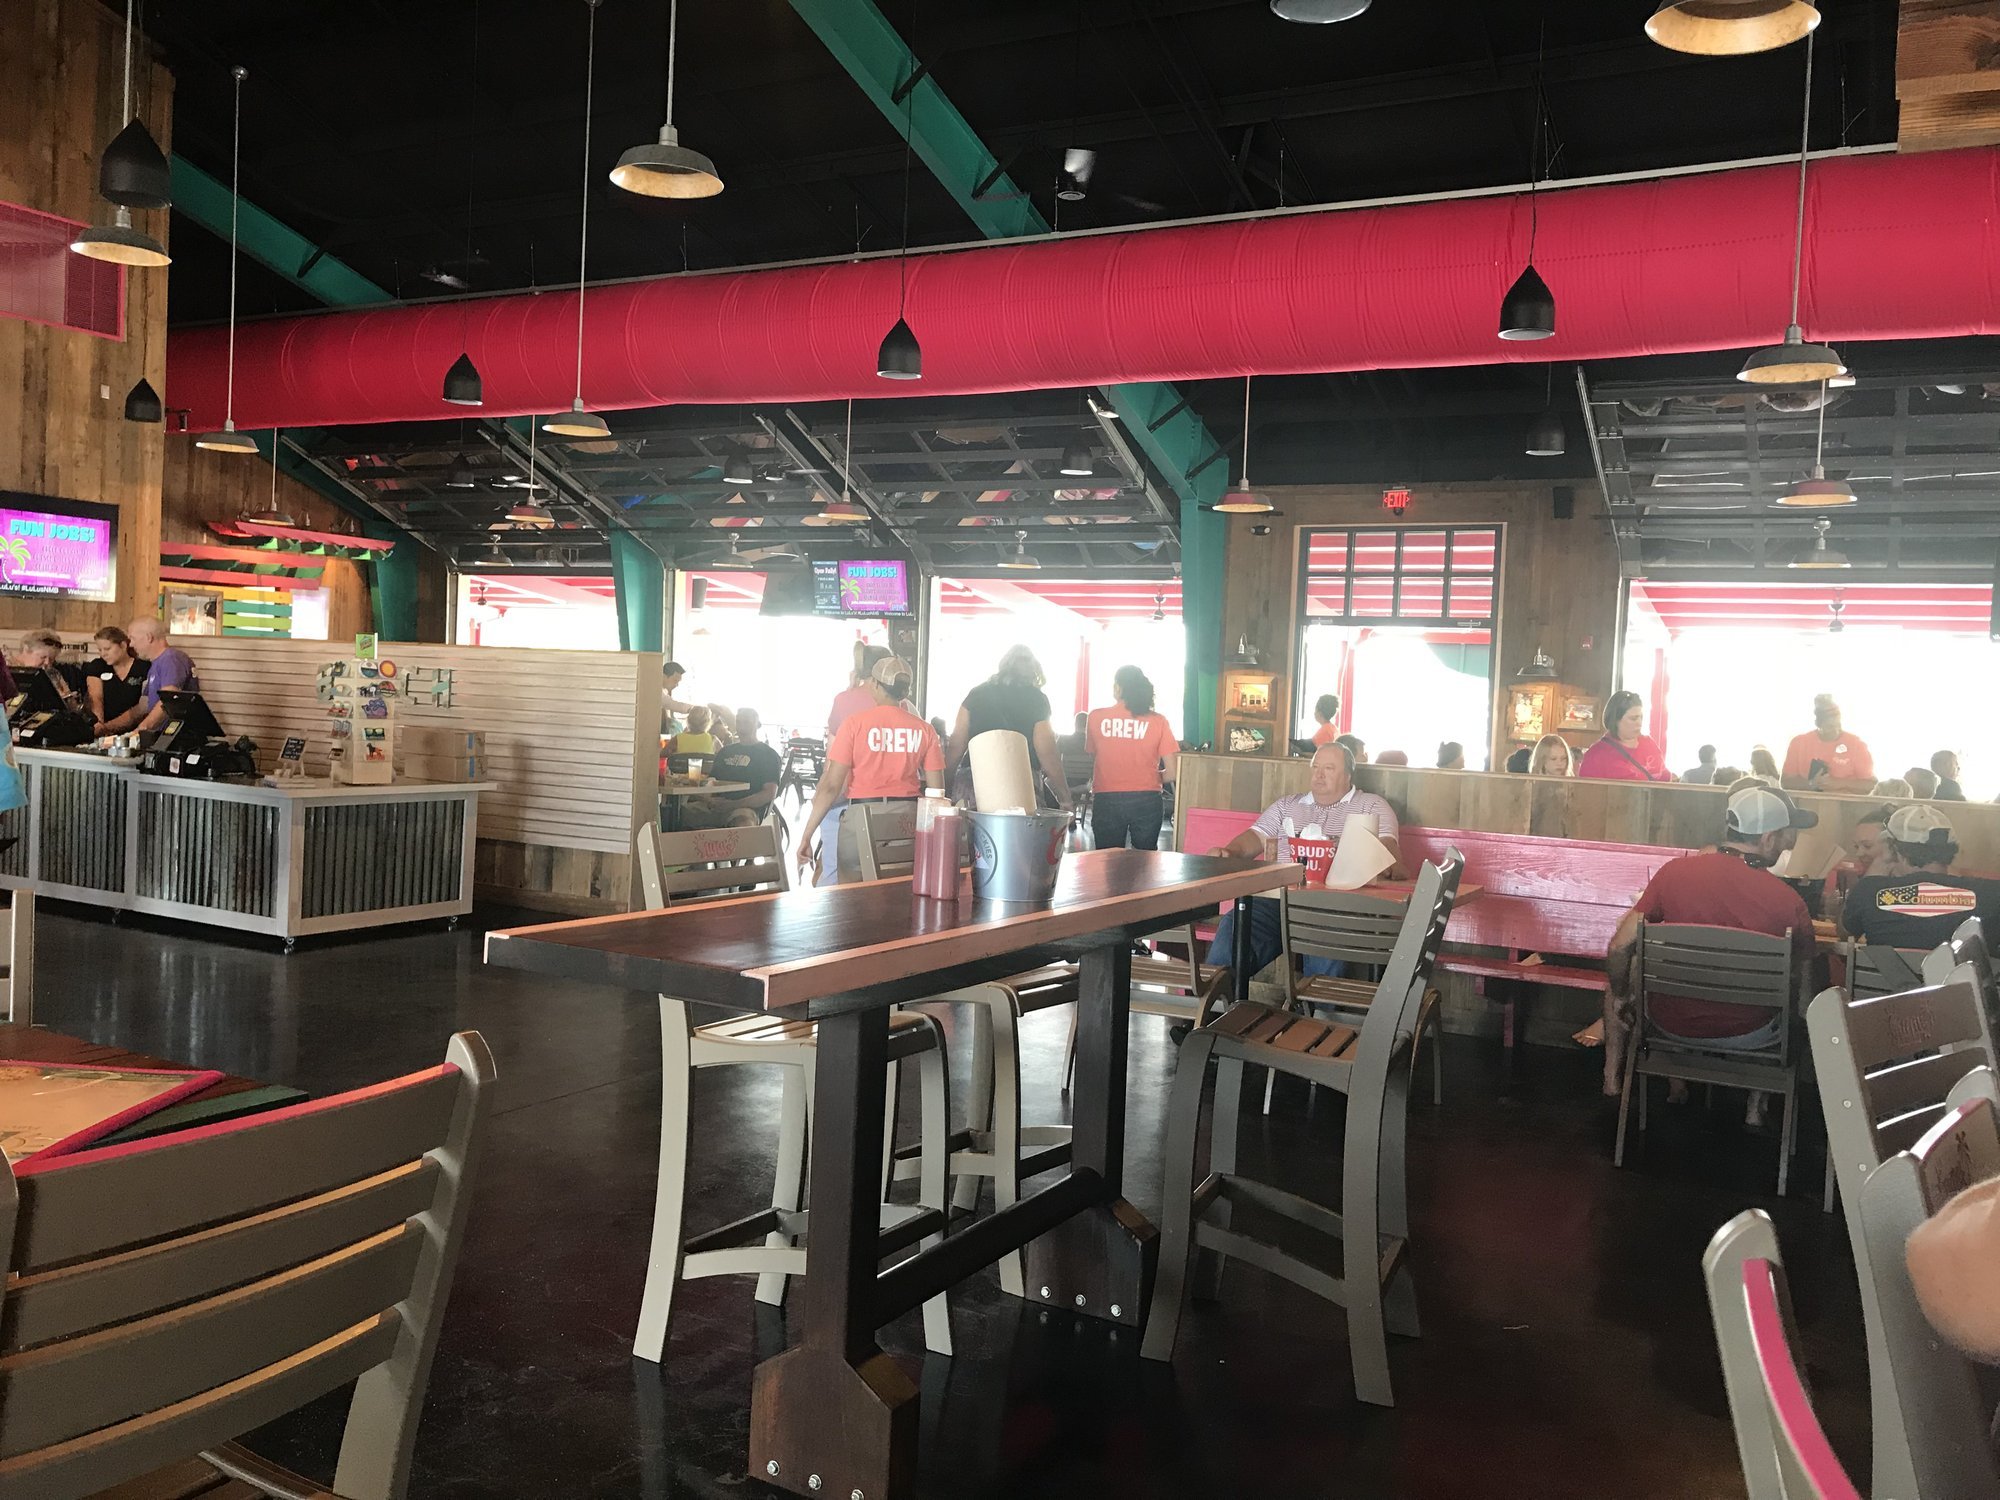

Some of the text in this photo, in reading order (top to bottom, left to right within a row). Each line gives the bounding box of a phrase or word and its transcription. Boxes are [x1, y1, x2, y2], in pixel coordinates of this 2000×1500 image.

[1387, 491, 1408, 508] EXIT
[11, 519, 95, 542] FUN JOBS!
[848, 567, 897, 577] FUN JOBS!
[1100, 718, 1149, 739] CREW
[867, 727, 923, 754] CREW
[1297, 845, 1336, 858] BUD'S
[1898, 894, 1972, 906] Columbia
